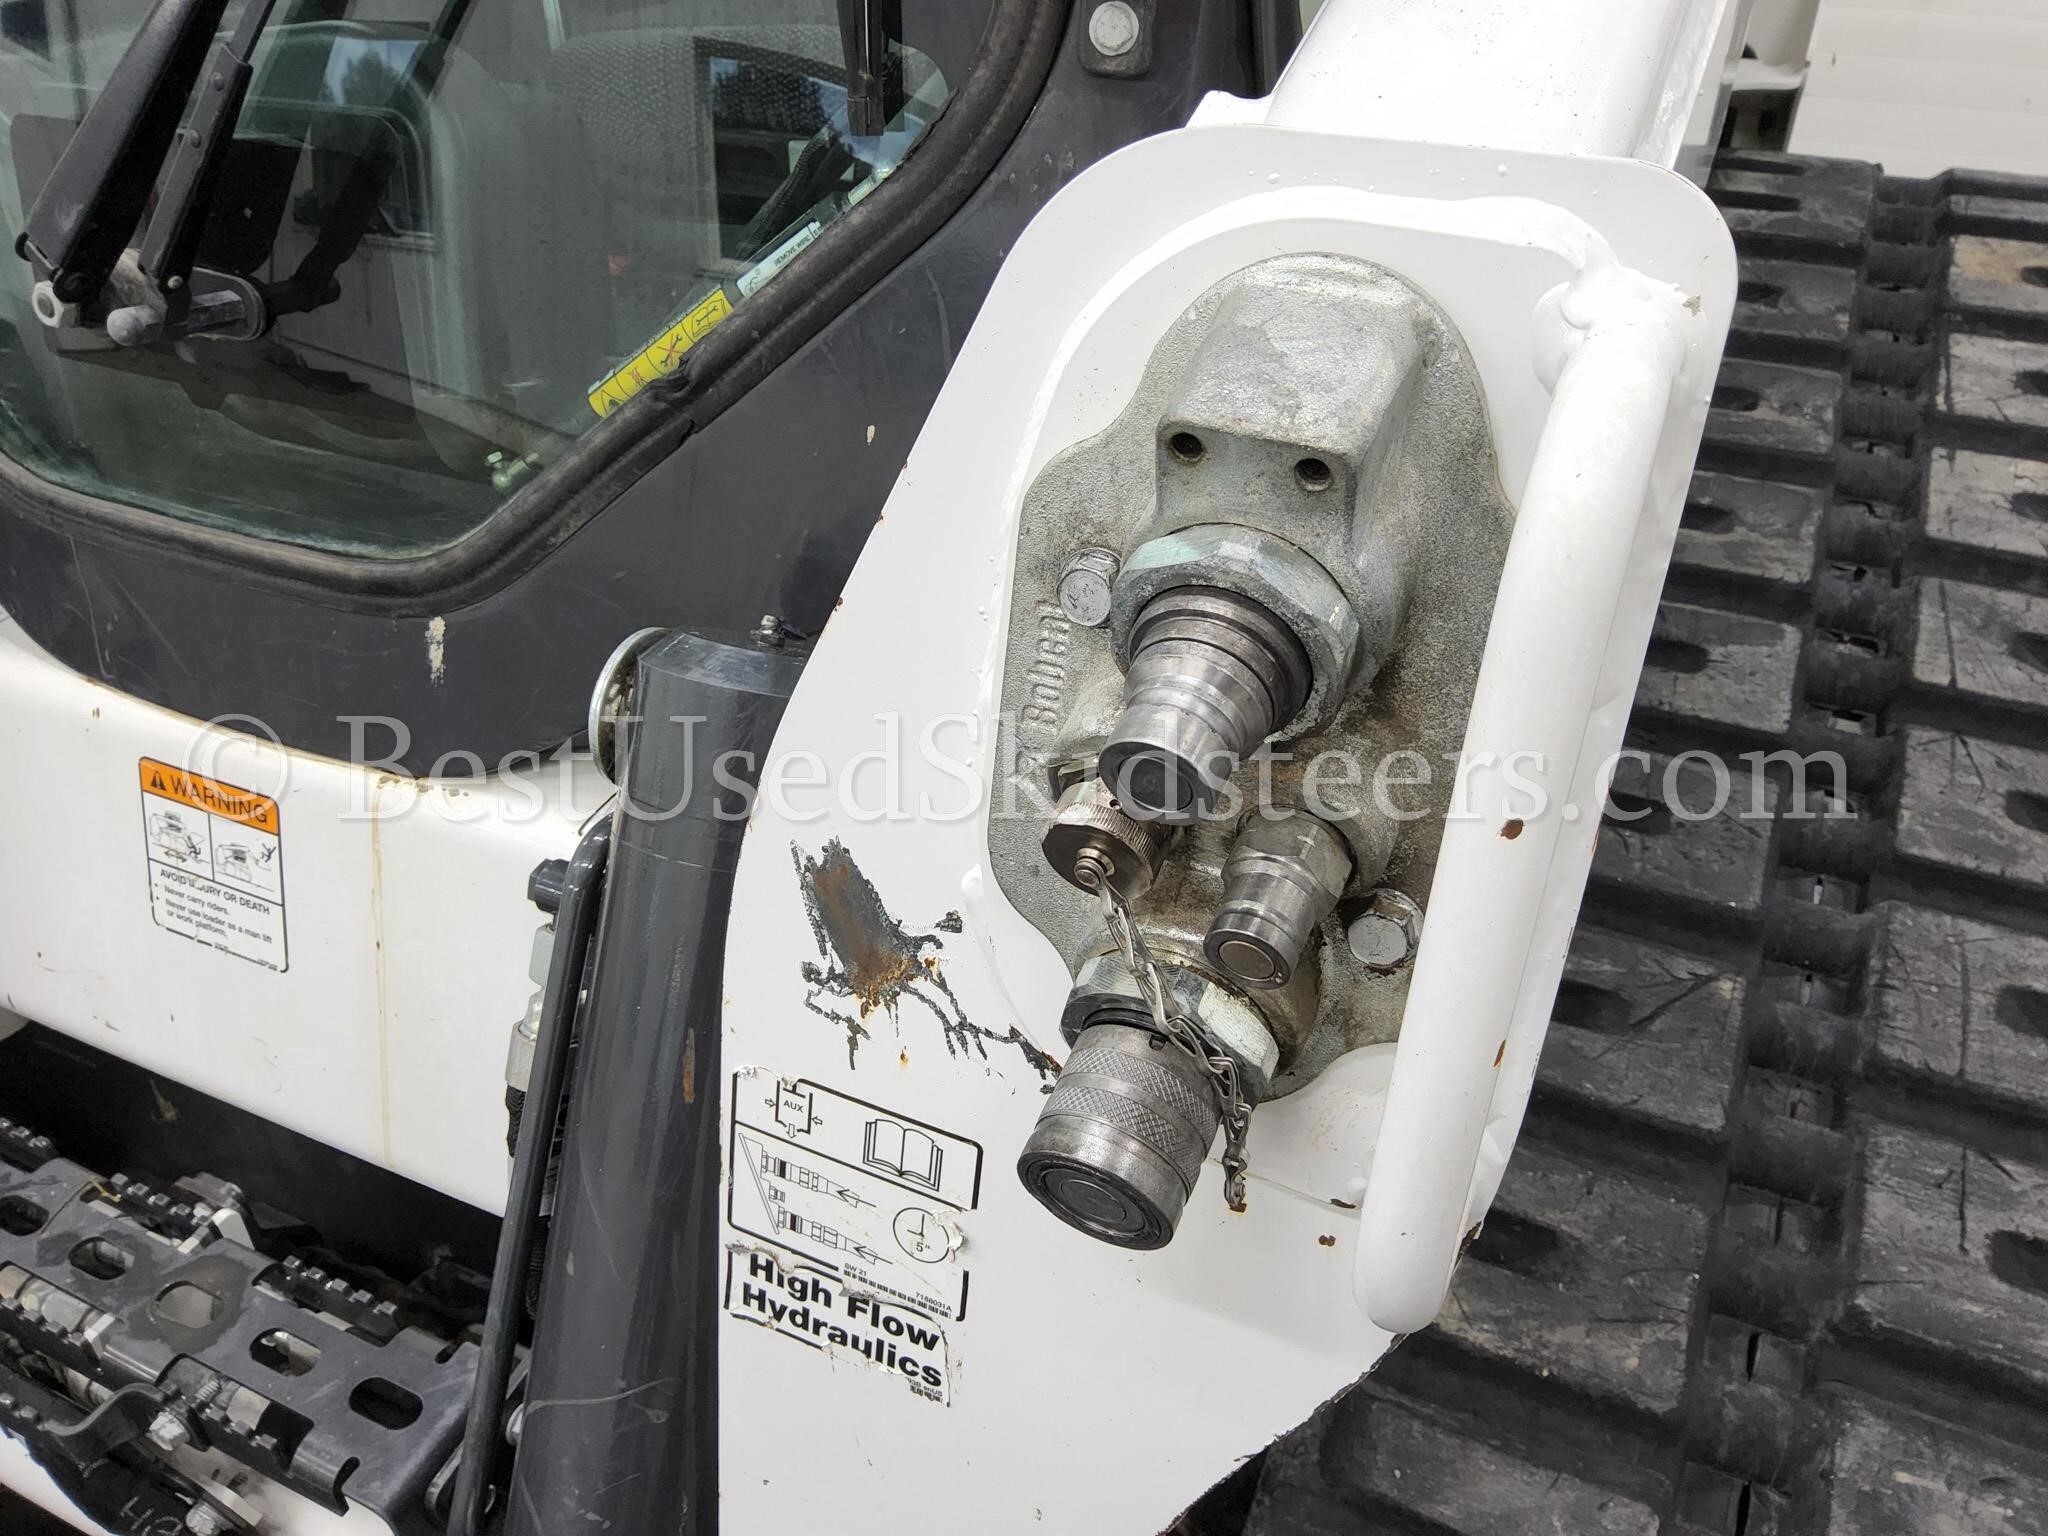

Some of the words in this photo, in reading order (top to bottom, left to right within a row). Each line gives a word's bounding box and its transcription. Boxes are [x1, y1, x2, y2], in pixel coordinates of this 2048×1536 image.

[170, 775, 268, 824] WARNING
[160, 869, 187, 885] AVOID
[223, 891, 237, 904] OR
[240, 897, 270, 915] DEATH
[164, 885, 185, 899] Never
[187, 895, 205, 908] carry
[165, 899, 186, 911] Never
[202, 911, 226, 926] loader
[783, 1099, 804, 1113] AUX
[750, 1253, 832, 1308] High
[847, 1294, 940, 1351] Flow
[743, 1282, 942, 1387] Hydraulics
